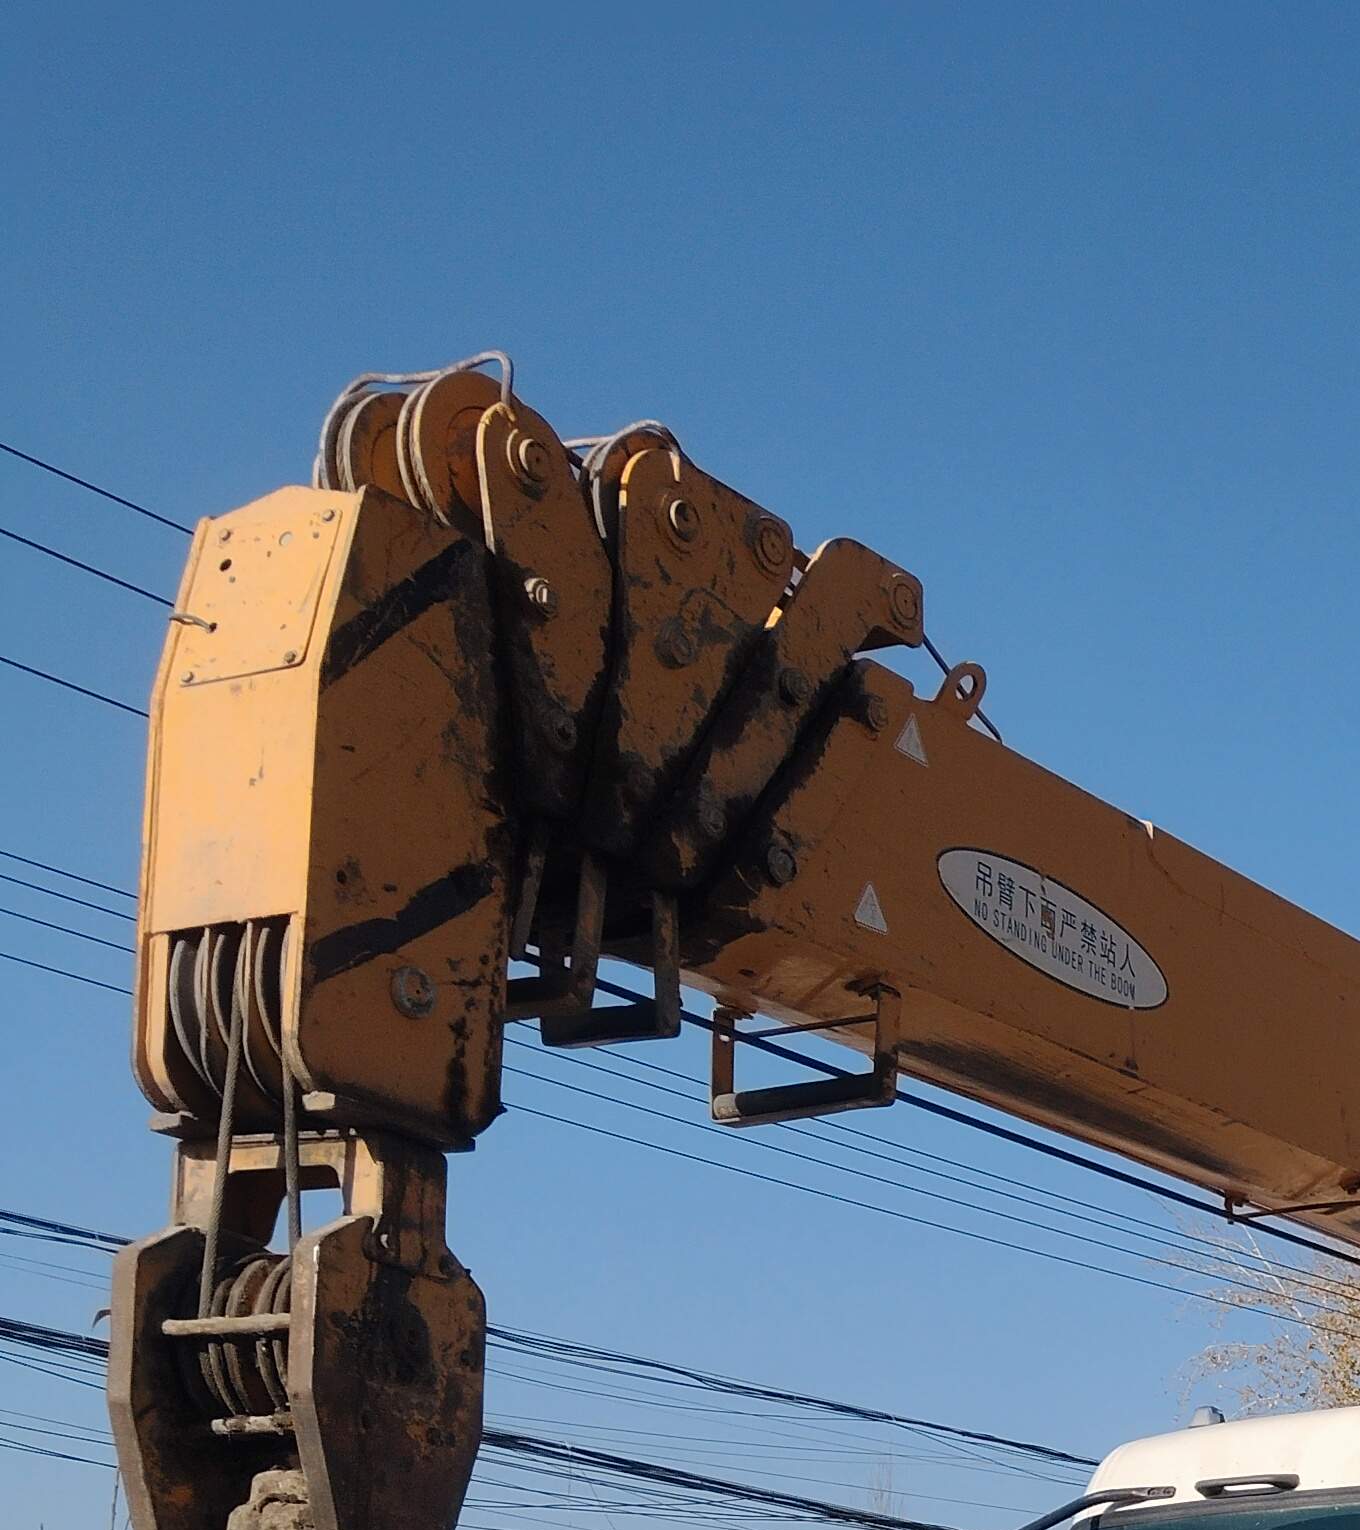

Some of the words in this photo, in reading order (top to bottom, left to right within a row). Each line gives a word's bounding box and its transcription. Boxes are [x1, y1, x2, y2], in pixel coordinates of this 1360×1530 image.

[974, 900, 988, 921] NO
[993, 909, 1047, 953] STANDING
[1052, 943, 1083, 973] UNDER
[1088, 961, 1106, 986] THE
[1110, 974, 1136, 1001] BOOM
[976, 861, 1136, 978] 吊臂下面严禁站人
